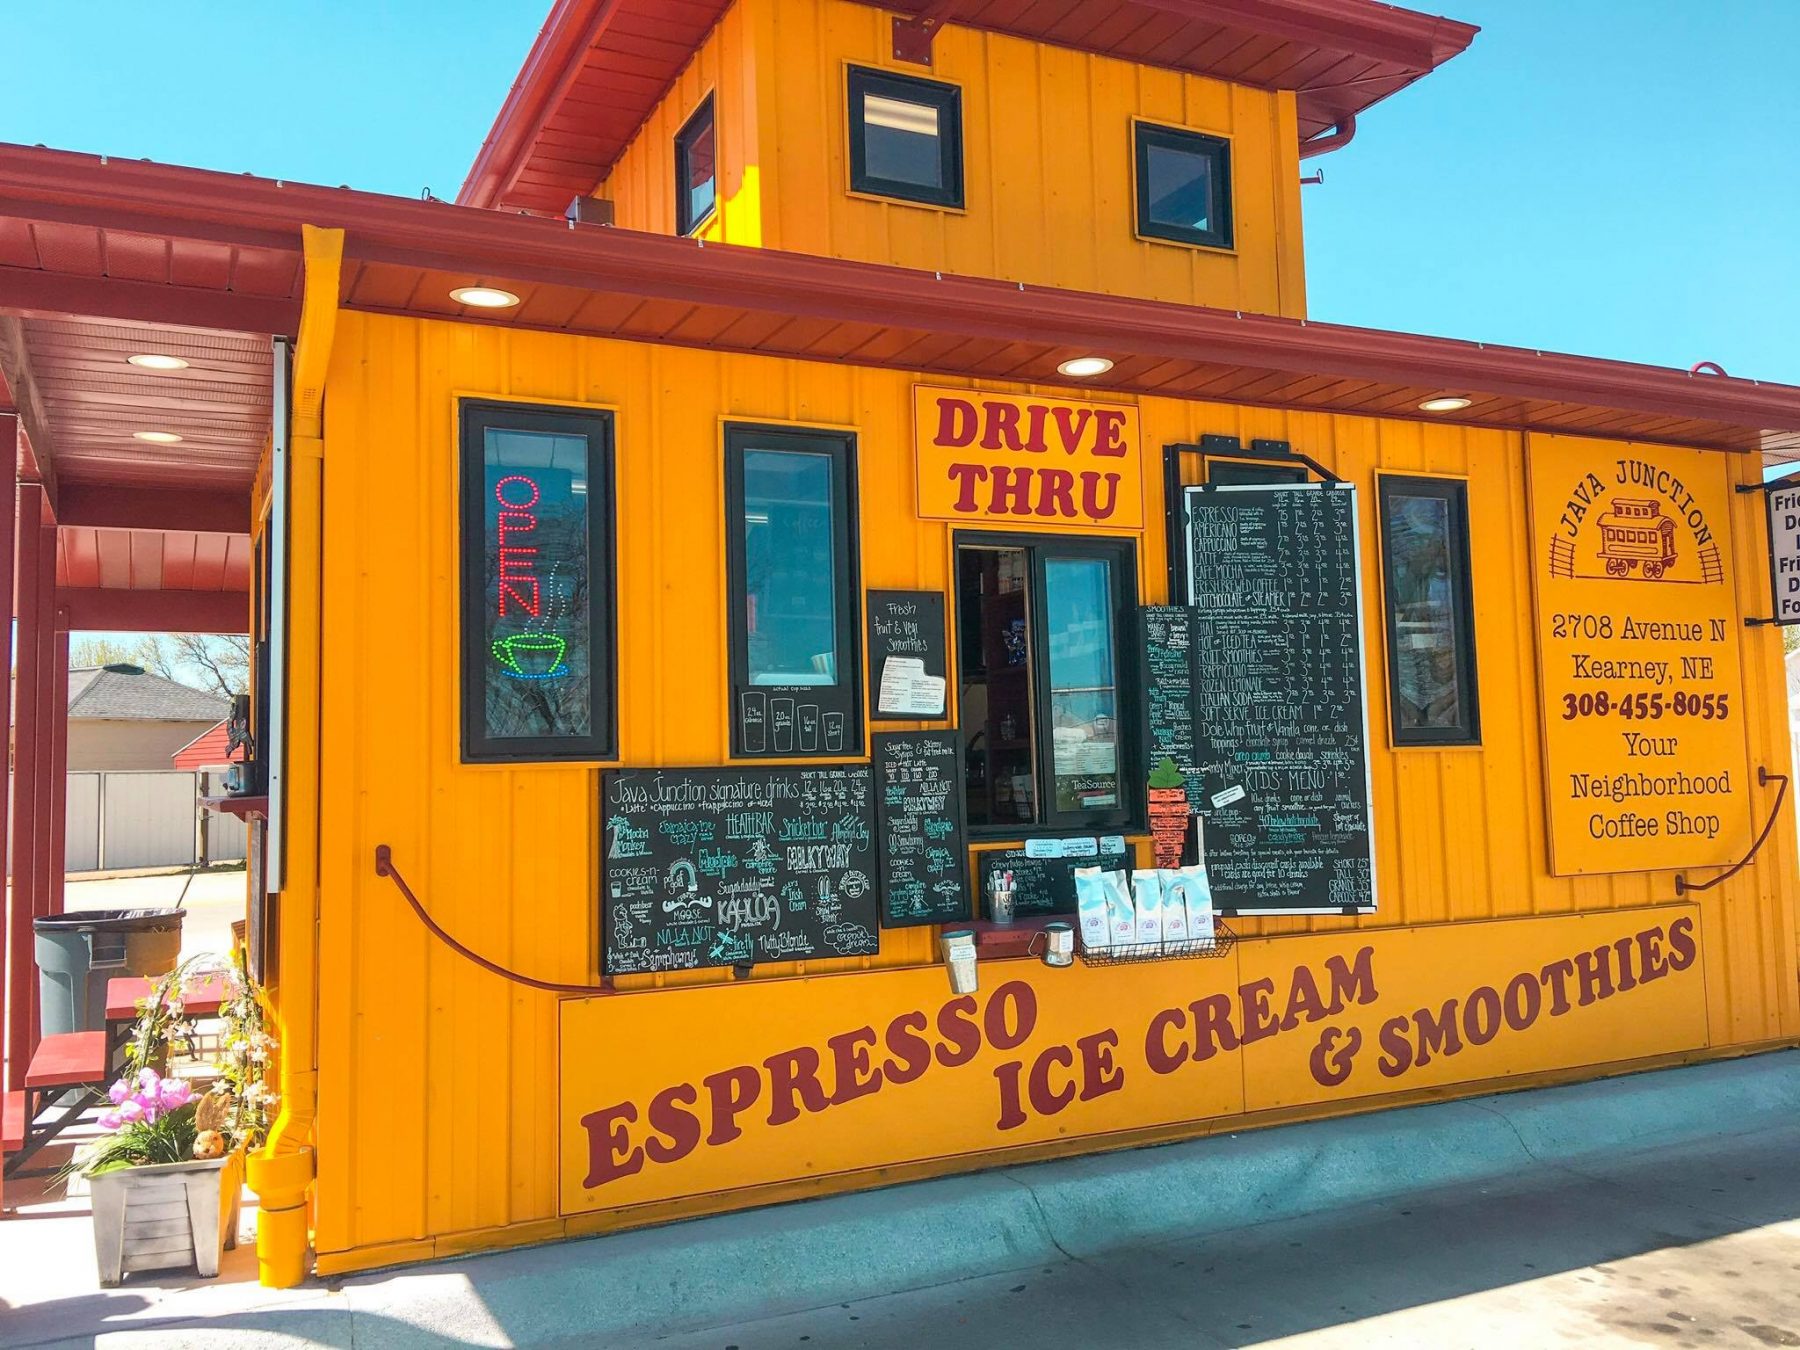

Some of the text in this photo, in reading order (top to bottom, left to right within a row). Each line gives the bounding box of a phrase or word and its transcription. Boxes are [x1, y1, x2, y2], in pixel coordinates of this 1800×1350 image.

[933, 398, 1127, 457] DRIVE
[948, 463, 1121, 519] THRU
[1560, 460, 1712, 546] JAVA JUNCTION
[1192, 506, 1239, 523] ESPRESSO
[1194, 522, 1238, 538] AMERICANO
[496, 475, 539, 617] OPEN
[1194, 537, 1238, 552] CAPPUCCINO
[1215, 564, 1244, 579] MOCHA
[1195, 578, 1278, 593] FRESH BREWED COFFEE
[1251, 591, 1286, 606] STEAMER
[886, 601, 916, 615] Fresh
[1147, 605, 1184, 613] SMOOTHIES
[874, 616, 893, 636] fruit
[1199, 621, 1214, 636] HAI
[1552, 614, 1726, 641] 2708 Avenue N
[1198, 635, 1213, 650] HOT
[1222, 634, 1241, 650] ICED
[1241, 634, 1257, 649] TEA
[1222, 649, 1262, 664] SMOOTHIES
[1572, 654, 1714, 685] Kearney, NE
[1200, 692, 1231, 706] ITALIAN
[1232, 691, 1254, 706] SODA
[1562, 691, 1729, 720] 308-455-8055
[1200, 706, 1221, 721] SOFT
[1222, 706, 1252, 720] SERVE
[1255, 706, 1270, 720] ICE
[1272, 705, 1303, 720] CREAM
[1201, 721, 1224, 737] Dole
[1244, 720, 1266, 736] fruit
[1274, 720, 1300, 737] Vanilla
[1210, 736, 1240, 757] toppings
[1622, 732, 1678, 757] Your
[610, 778, 648, 804] Java
[649, 771, 706, 802] Junction
[709, 776, 761, 803] signature
[765, 776, 799, 800] drinks
[1072, 779, 1116, 791] TeaSource
[1246, 771, 1280, 791] KIDS
[1289, 770, 1324, 790] MENU
[1570, 771, 1732, 803] Neighborhood
[1589, 811, 1720, 839] Coffee Shop
[1333, 858, 1355, 869] SHORT
[626, 875, 657, 886] cream
[1278, 868, 1285, 878] 10
[1334, 869, 1355, 880] TALL
[788, 887, 803, 900] Irish
[1328, 879, 1356, 892] GRANDE
[779, 929, 809, 948] Blonde
[1309, 918, 1697, 1087] & SMOOTHIES
[993, 947, 1379, 1131] ICE CREAM
[580, 980, 1037, 1189] ESPRESSO
